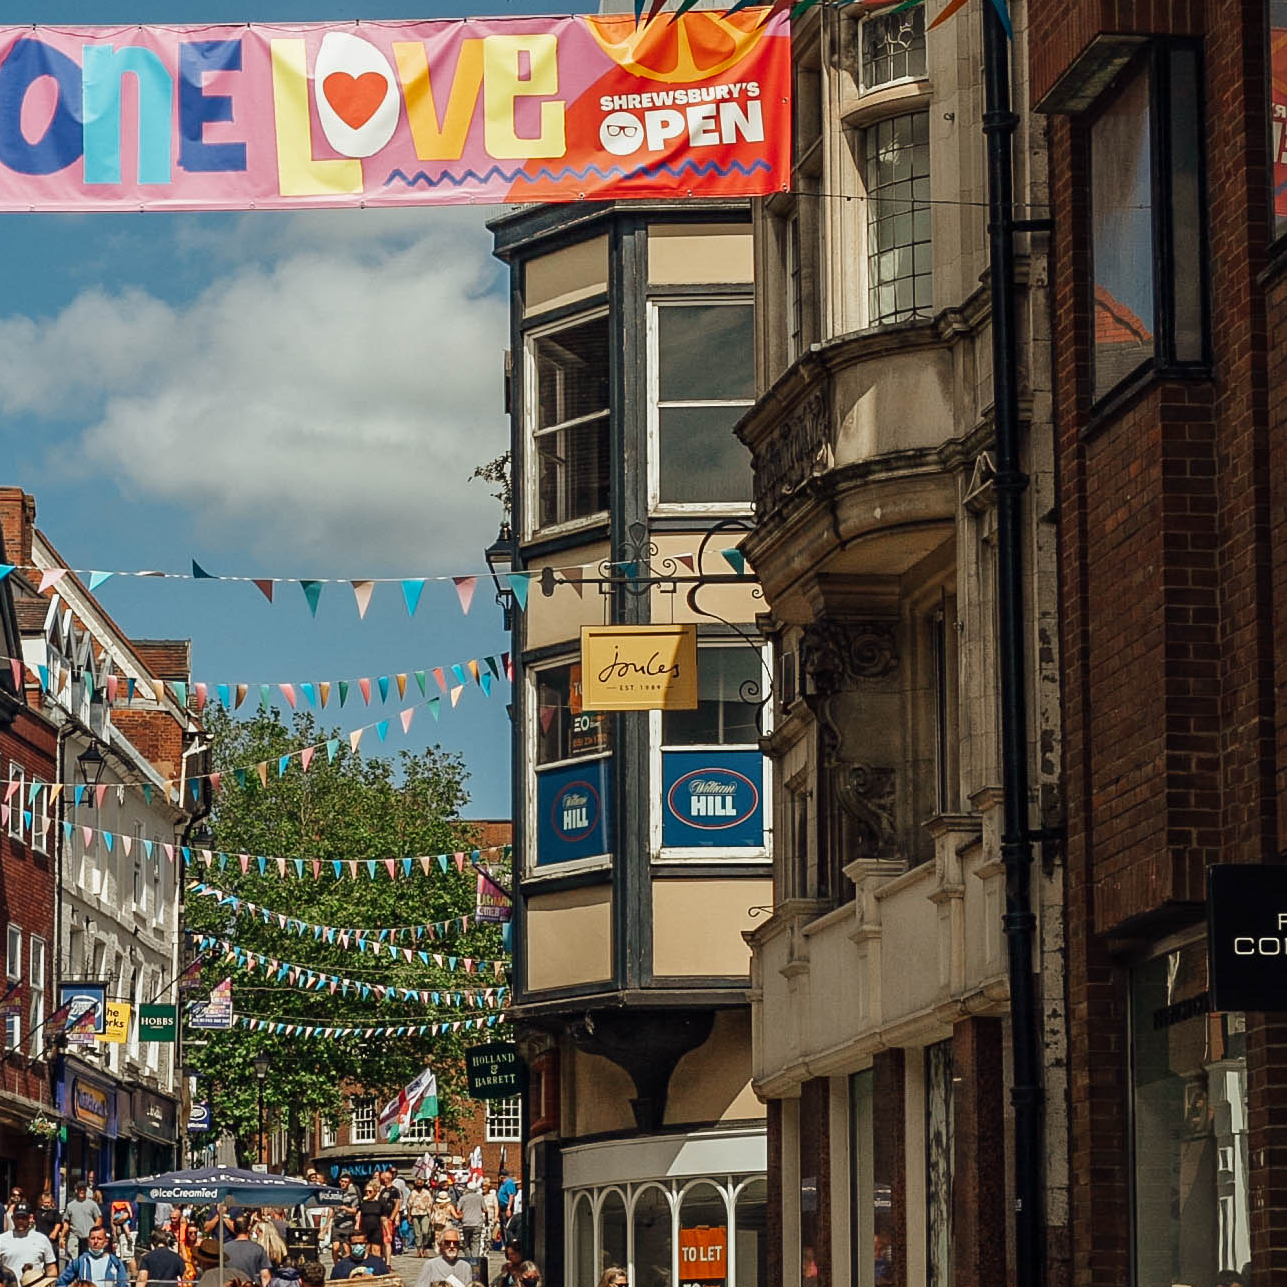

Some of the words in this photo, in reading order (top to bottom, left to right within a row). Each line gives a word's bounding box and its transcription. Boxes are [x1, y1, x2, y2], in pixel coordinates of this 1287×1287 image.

[600, 81, 760, 112] SHREWSBURY'S
[599, 99, 765, 156] OPEN
[688, 779, 738, 796] William
[690, 796, 737, 817] HILL
[563, 807, 589, 831] HILL
[141, 1017, 174, 1026] HOBBS
[473, 1053, 515, 1067] HOLLAND
[475, 1073, 516, 1088] BARRETT
[149, 1188, 218, 1199] @IceCreamTed
[682, 1246, 697, 1262] TO
[699, 1245, 722, 1262] LET
